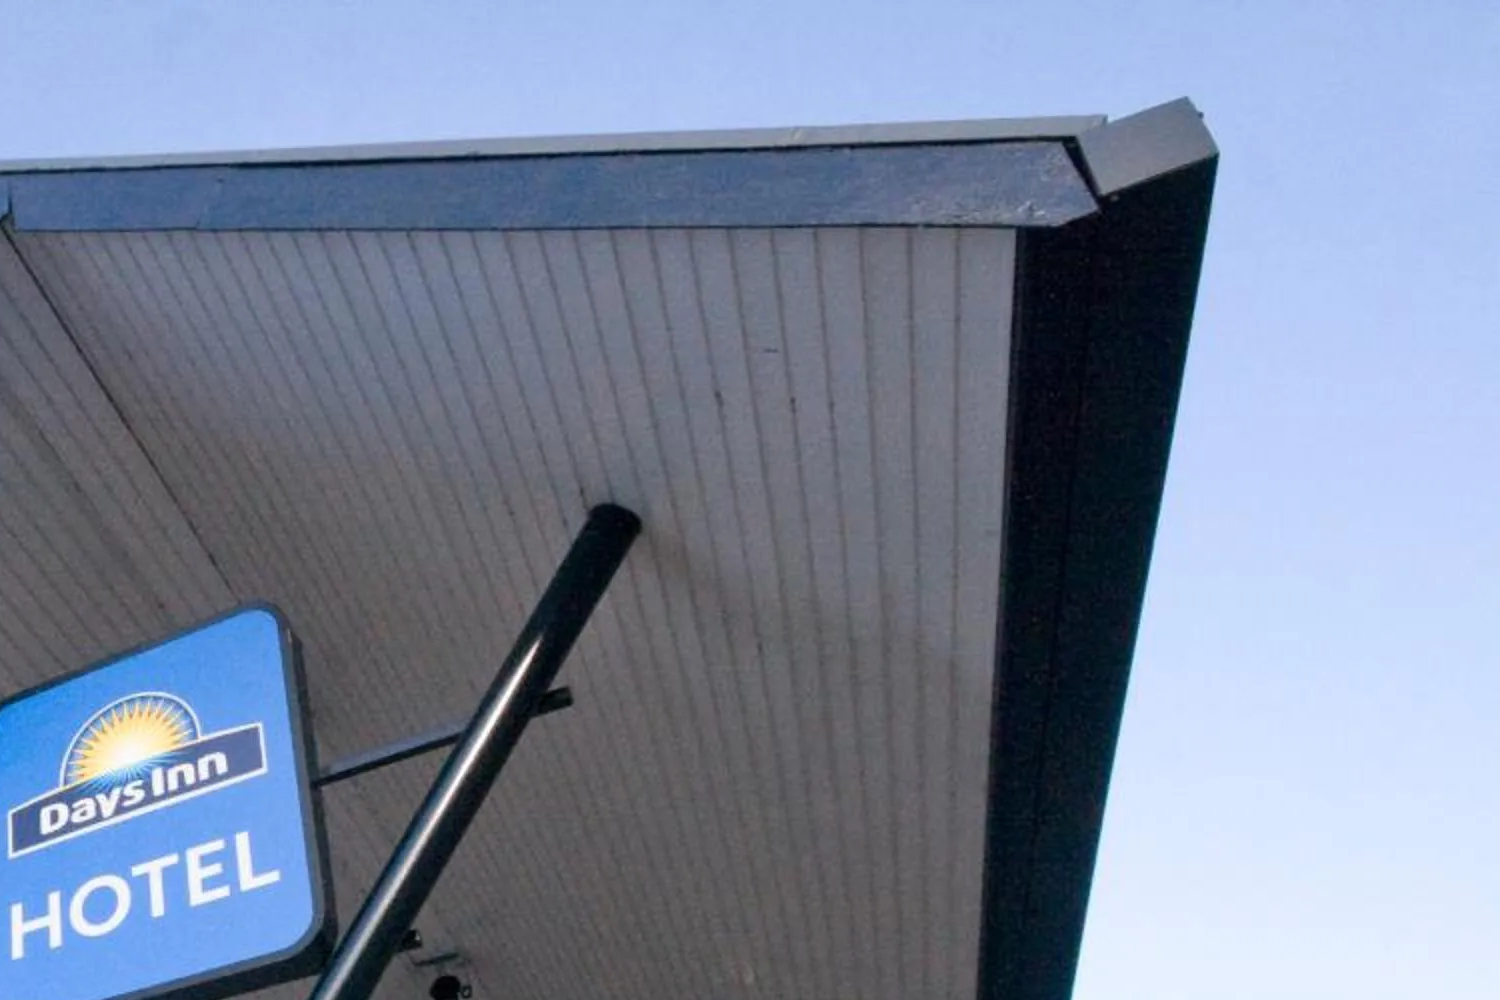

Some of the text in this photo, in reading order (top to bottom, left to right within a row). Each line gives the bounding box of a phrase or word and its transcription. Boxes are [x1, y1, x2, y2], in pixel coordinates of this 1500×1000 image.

[39, 752, 228, 835] Days Inn
[10, 831, 280, 960] HOTEL
